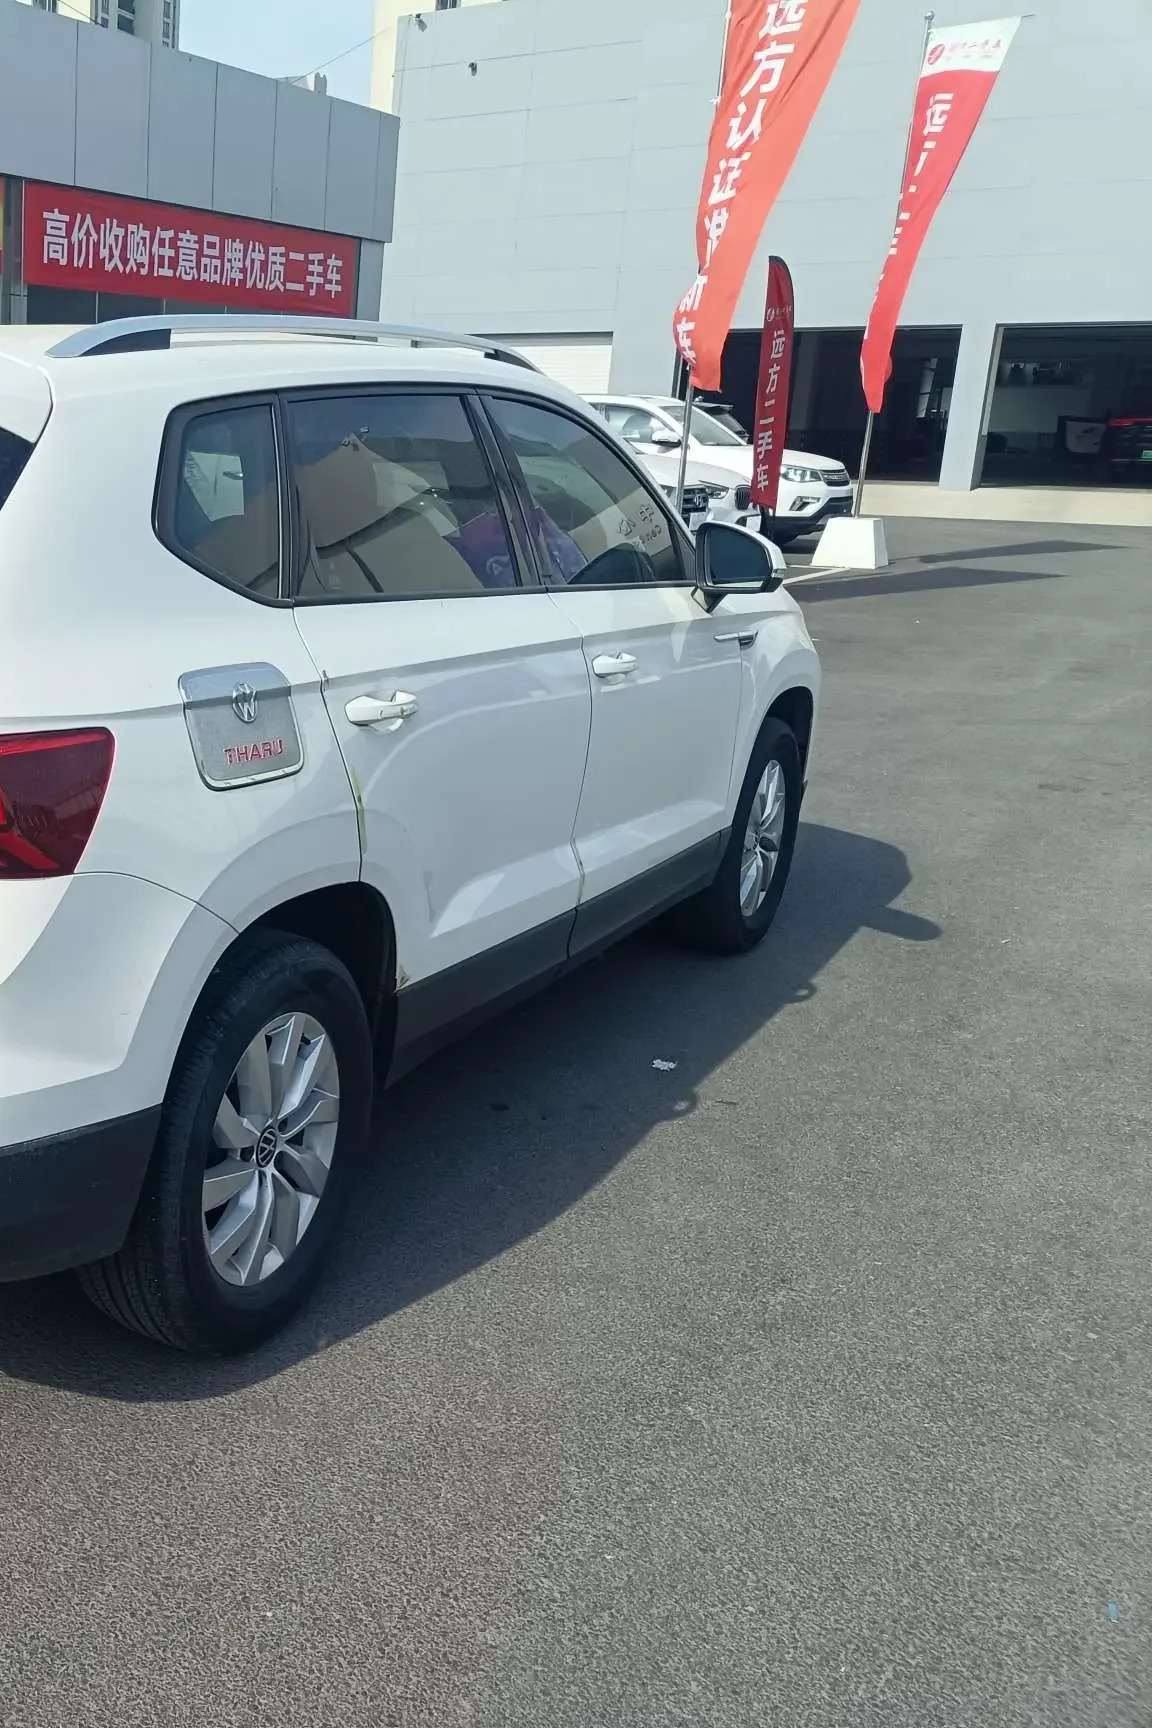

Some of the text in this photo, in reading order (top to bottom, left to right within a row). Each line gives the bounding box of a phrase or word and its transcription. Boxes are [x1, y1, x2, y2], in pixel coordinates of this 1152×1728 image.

[42, 208, 344, 299] 高价收购任意品牌优质二手车
[756, 330, 786, 492] 远方二手车
[223, 739, 285, 766] THARU
